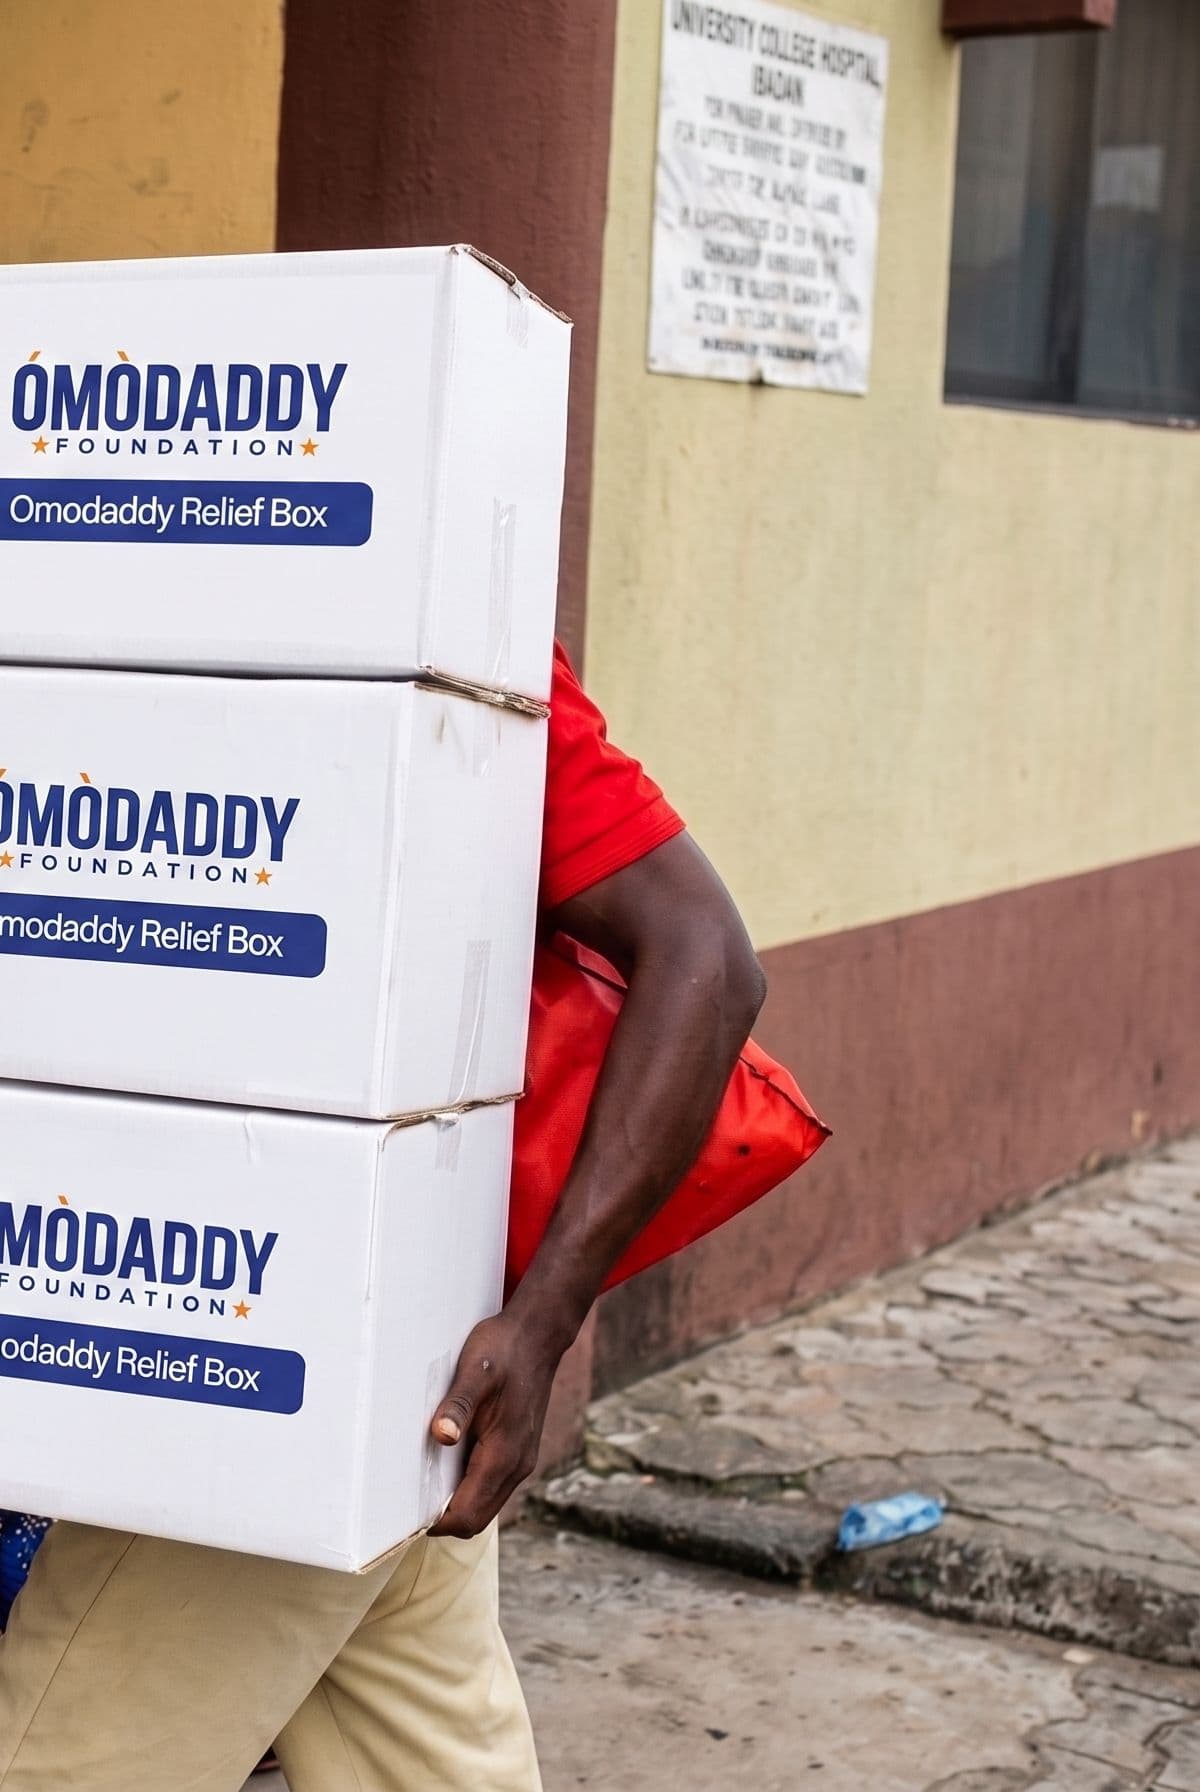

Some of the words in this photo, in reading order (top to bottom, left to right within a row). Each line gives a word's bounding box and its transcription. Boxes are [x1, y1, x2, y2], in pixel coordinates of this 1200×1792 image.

[671, 0, 756, 51] UNIVERSITY
[758, 23, 816, 69] COLLEGE
[821, 41, 883, 89] HOSPITAL
[56, 438, 294, 455] FOUNDATION
[9, 494, 175, 534] Omodaddy
[181, 496, 266, 527] Relief
[270, 497, 329, 528] Box
[20, 853, 247, 884] FOUNDATION
[140, 918, 223, 953] Relief
[227, 924, 284, 958] Box
[116, 1346, 199, 1384] Relief
[203, 1357, 261, 1392] Box
